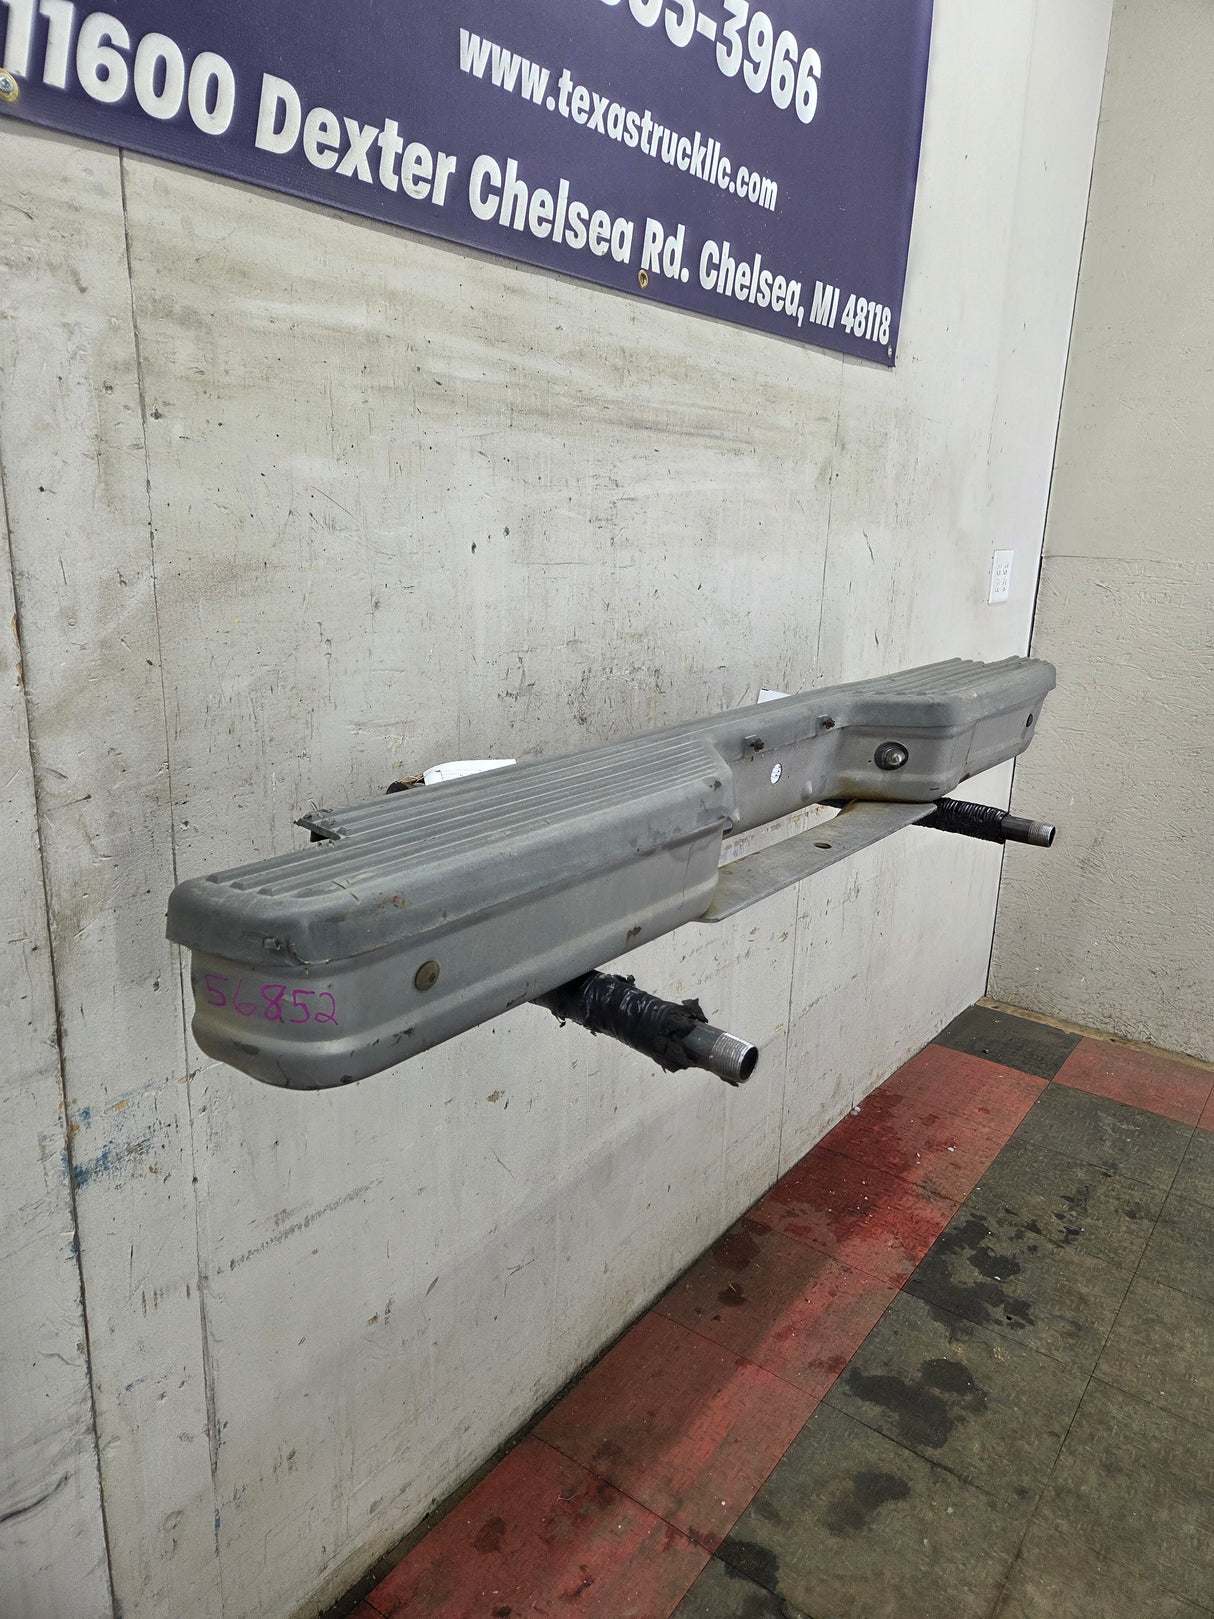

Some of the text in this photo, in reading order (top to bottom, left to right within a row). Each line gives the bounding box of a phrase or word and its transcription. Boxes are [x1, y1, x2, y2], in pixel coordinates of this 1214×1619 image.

[1, 0, 892, 345] 11600 Dexter Chelsea Rd. Chelsea, MI 48118
[459, 27, 778, 211] www.texastruckllc.com
[204, 973, 338, 1026] 56852
